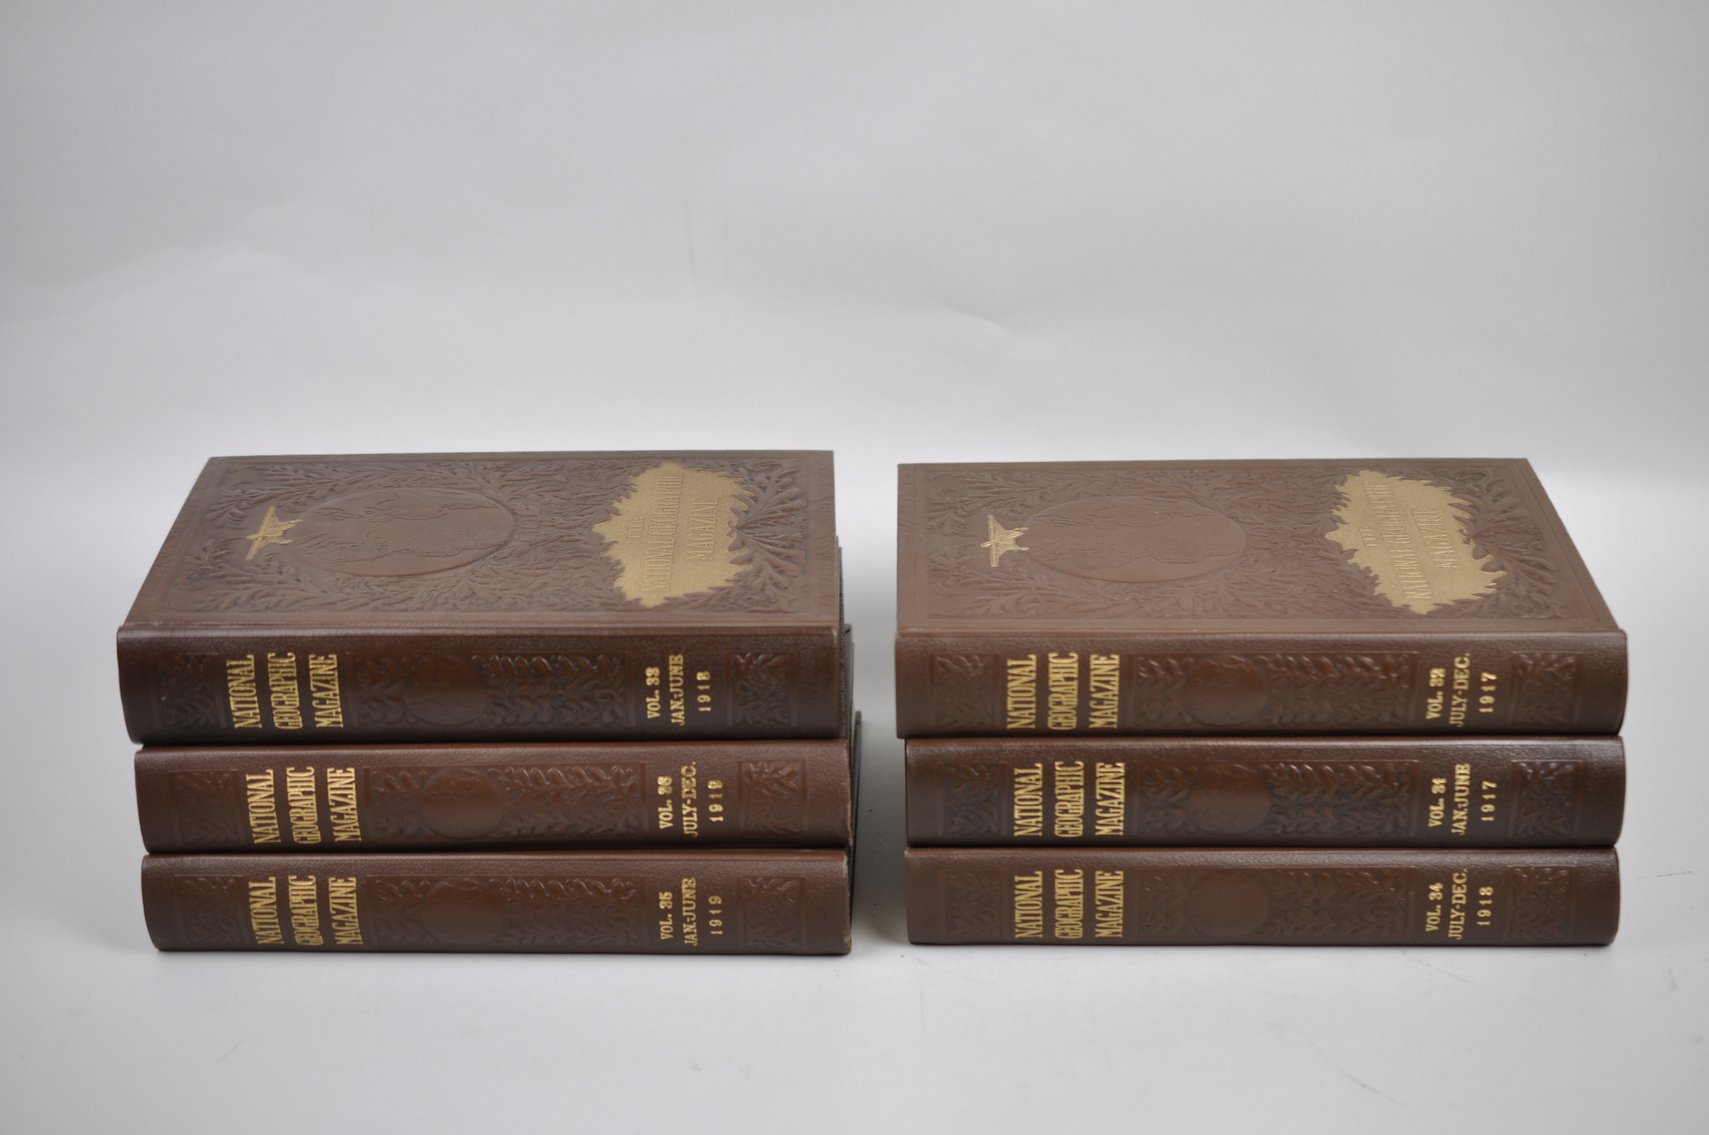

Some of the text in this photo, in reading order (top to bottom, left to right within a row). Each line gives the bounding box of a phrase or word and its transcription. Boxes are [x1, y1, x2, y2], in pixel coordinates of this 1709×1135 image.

[687, 497, 717, 559] MAGAZINE
[1412, 505, 1459, 568] MAGAZINE
[1392, 548, 1432, 599] NATIONAL
[226, 654, 262, 728] NATIONAL
[268, 652, 303, 730] GEOGRAPHIC
[308, 654, 344, 728] MAGAZINE
[646, 690, 660, 719] VOL.
[696, 671, 711, 712] 1918
[1006, 654, 1037, 730] NATIONAL
[1048, 652, 1079, 730] GEOGRAPHIC
[1089, 654, 1120, 729] MAGAZINE
[1426, 691, 1444, 719] VOL.
[1449, 653, 1471, 727] JULY-DEC.
[1479, 671, 1498, 713] 1917
[246, 768, 282, 844] NATIONAL
[286, 766, 322, 844] GEOGRAPHIC
[326, 767, 362, 842] MAGAZINE
[659, 800, 674, 829] VOL.
[680, 761, 699, 837] JULY-DEC.
[1013, 763, 1043, 836] NATIONAL
[1054, 761, 1085, 838] GEOGRAPHIC
[1094, 762, 1126, 836] MAGAZINE
[1428, 798, 1445, 828] VOL.
[1481, 780, 1497, 821] 1917
[248, 877, 284, 944] NATIONAL
[288, 874, 324, 946] GEOGRAPHIC
[328, 877, 363, 945] MAGAZINE
[659, 892, 674, 940] VOL. 35
[708, 896, 722, 934] 1919
[1014, 871, 1043, 938] NATIONAL
[1054, 869, 1084, 939] GEOGRAPHIC
[1095, 870, 1124, 938] MAGAZINE
[1425, 883, 1444, 932] VOL. 34
[1448, 868, 1468, 940] JULY-DEC.
[1476, 886, 1494, 926] 1918
